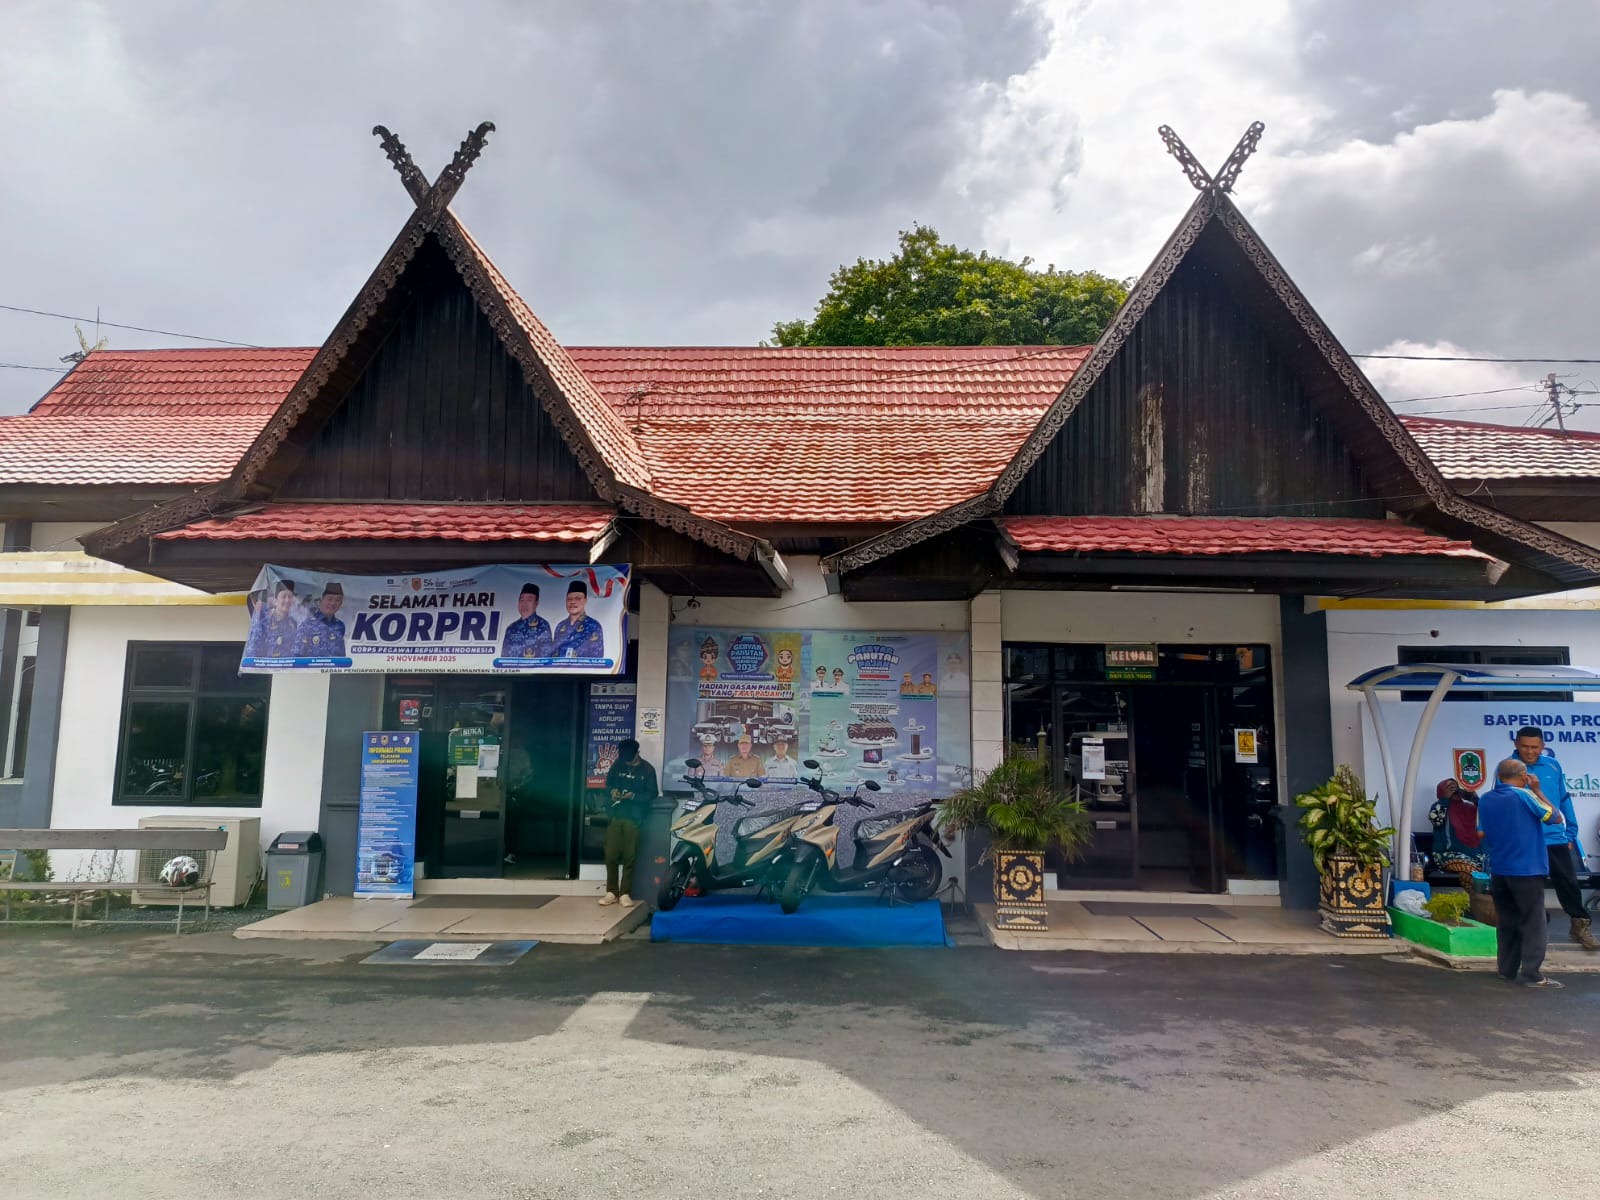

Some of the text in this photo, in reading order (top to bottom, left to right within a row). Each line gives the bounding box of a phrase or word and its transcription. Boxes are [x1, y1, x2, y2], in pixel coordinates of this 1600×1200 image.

[368, 592, 496, 610] SELAMAT HARI
[351, 610, 501, 642] KORPRI
[848, 653, 899, 664] PANUTAN
[1111, 651, 1154, 661] KELUAR
[1483, 714, 1566, 726] BAPENDA
